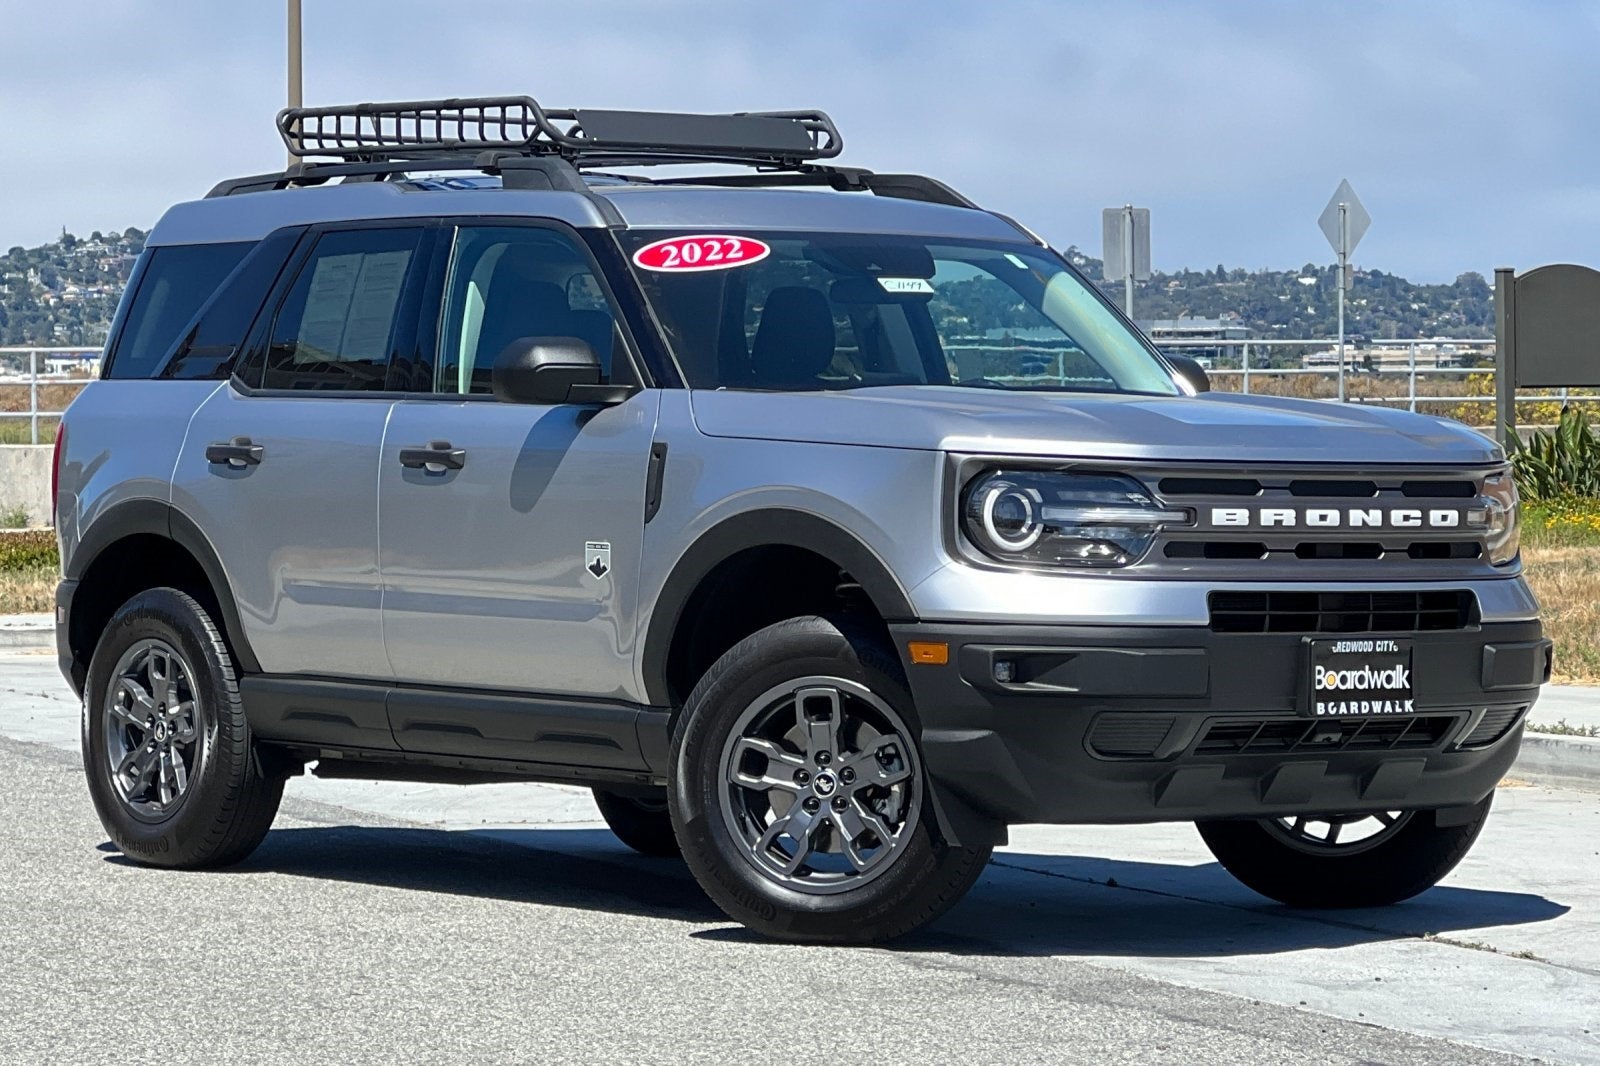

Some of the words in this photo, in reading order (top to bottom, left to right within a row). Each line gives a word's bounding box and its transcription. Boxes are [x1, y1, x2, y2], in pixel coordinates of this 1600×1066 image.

[660, 239, 743, 267] 2022
[1211, 508, 1459, 527] BRONCO
[1335, 641, 1373, 653] REDWOOD
[1376, 641, 1394, 652] CITY
[1315, 664, 1411, 690] Boardwalk
[1316, 698, 1414, 715] BOARDWALK
